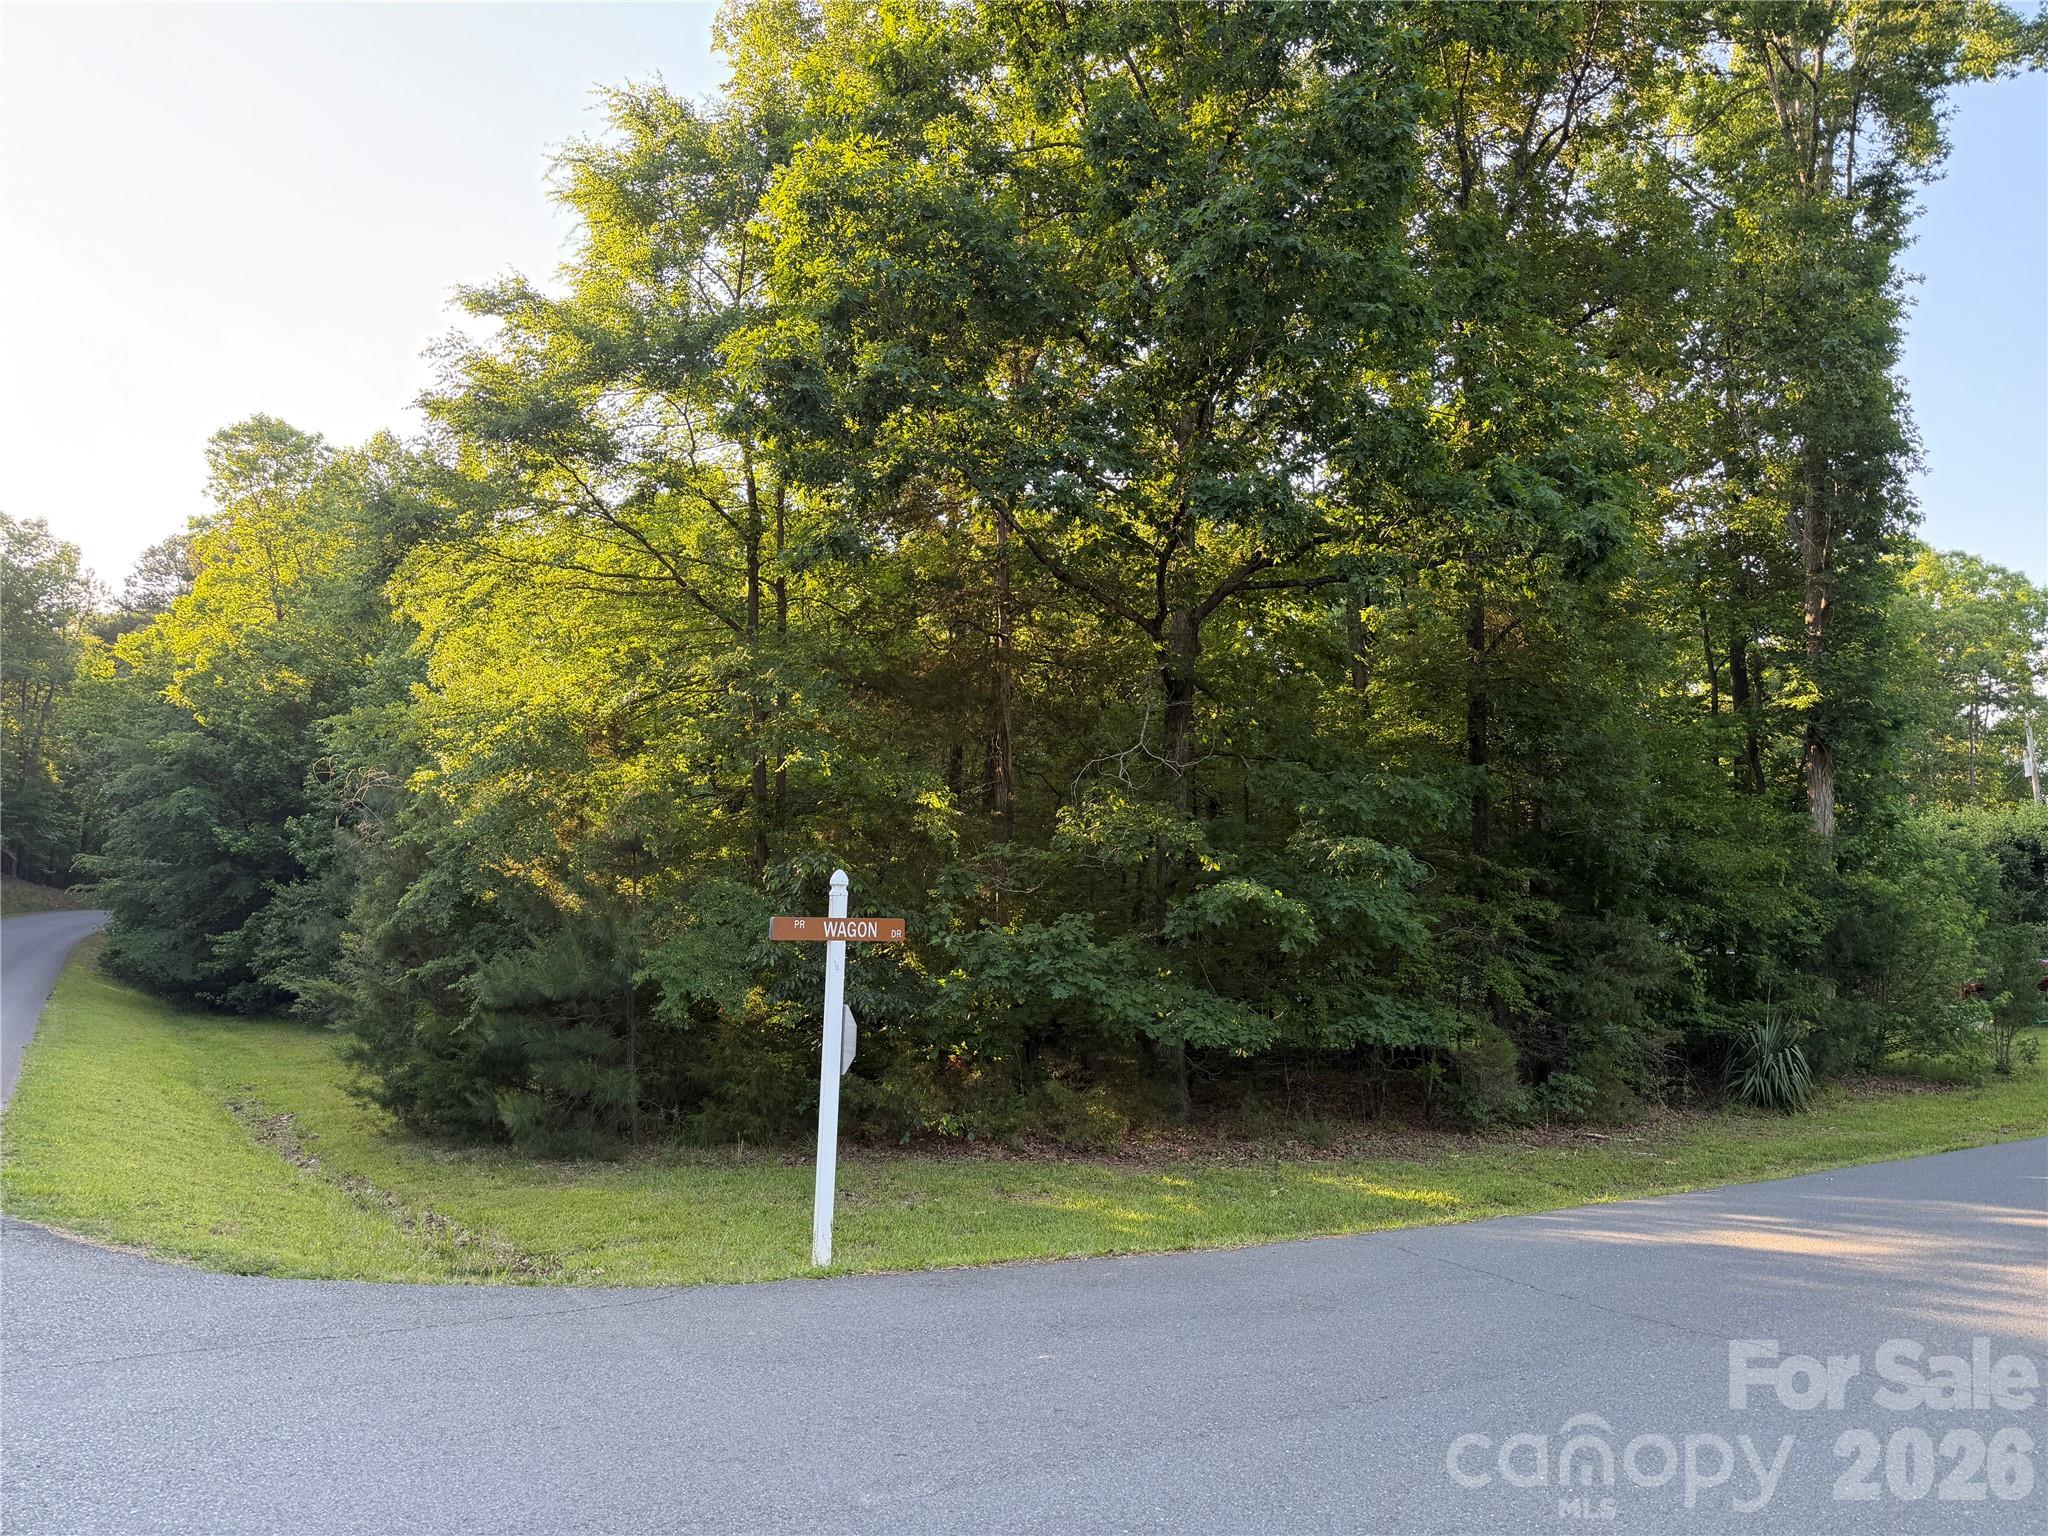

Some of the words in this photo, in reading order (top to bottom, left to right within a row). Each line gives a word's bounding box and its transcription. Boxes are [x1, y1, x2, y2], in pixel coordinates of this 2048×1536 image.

[794, 919, 805, 929] PR
[823, 921, 878, 938] WAGON
[891, 929, 902, 938] DR
